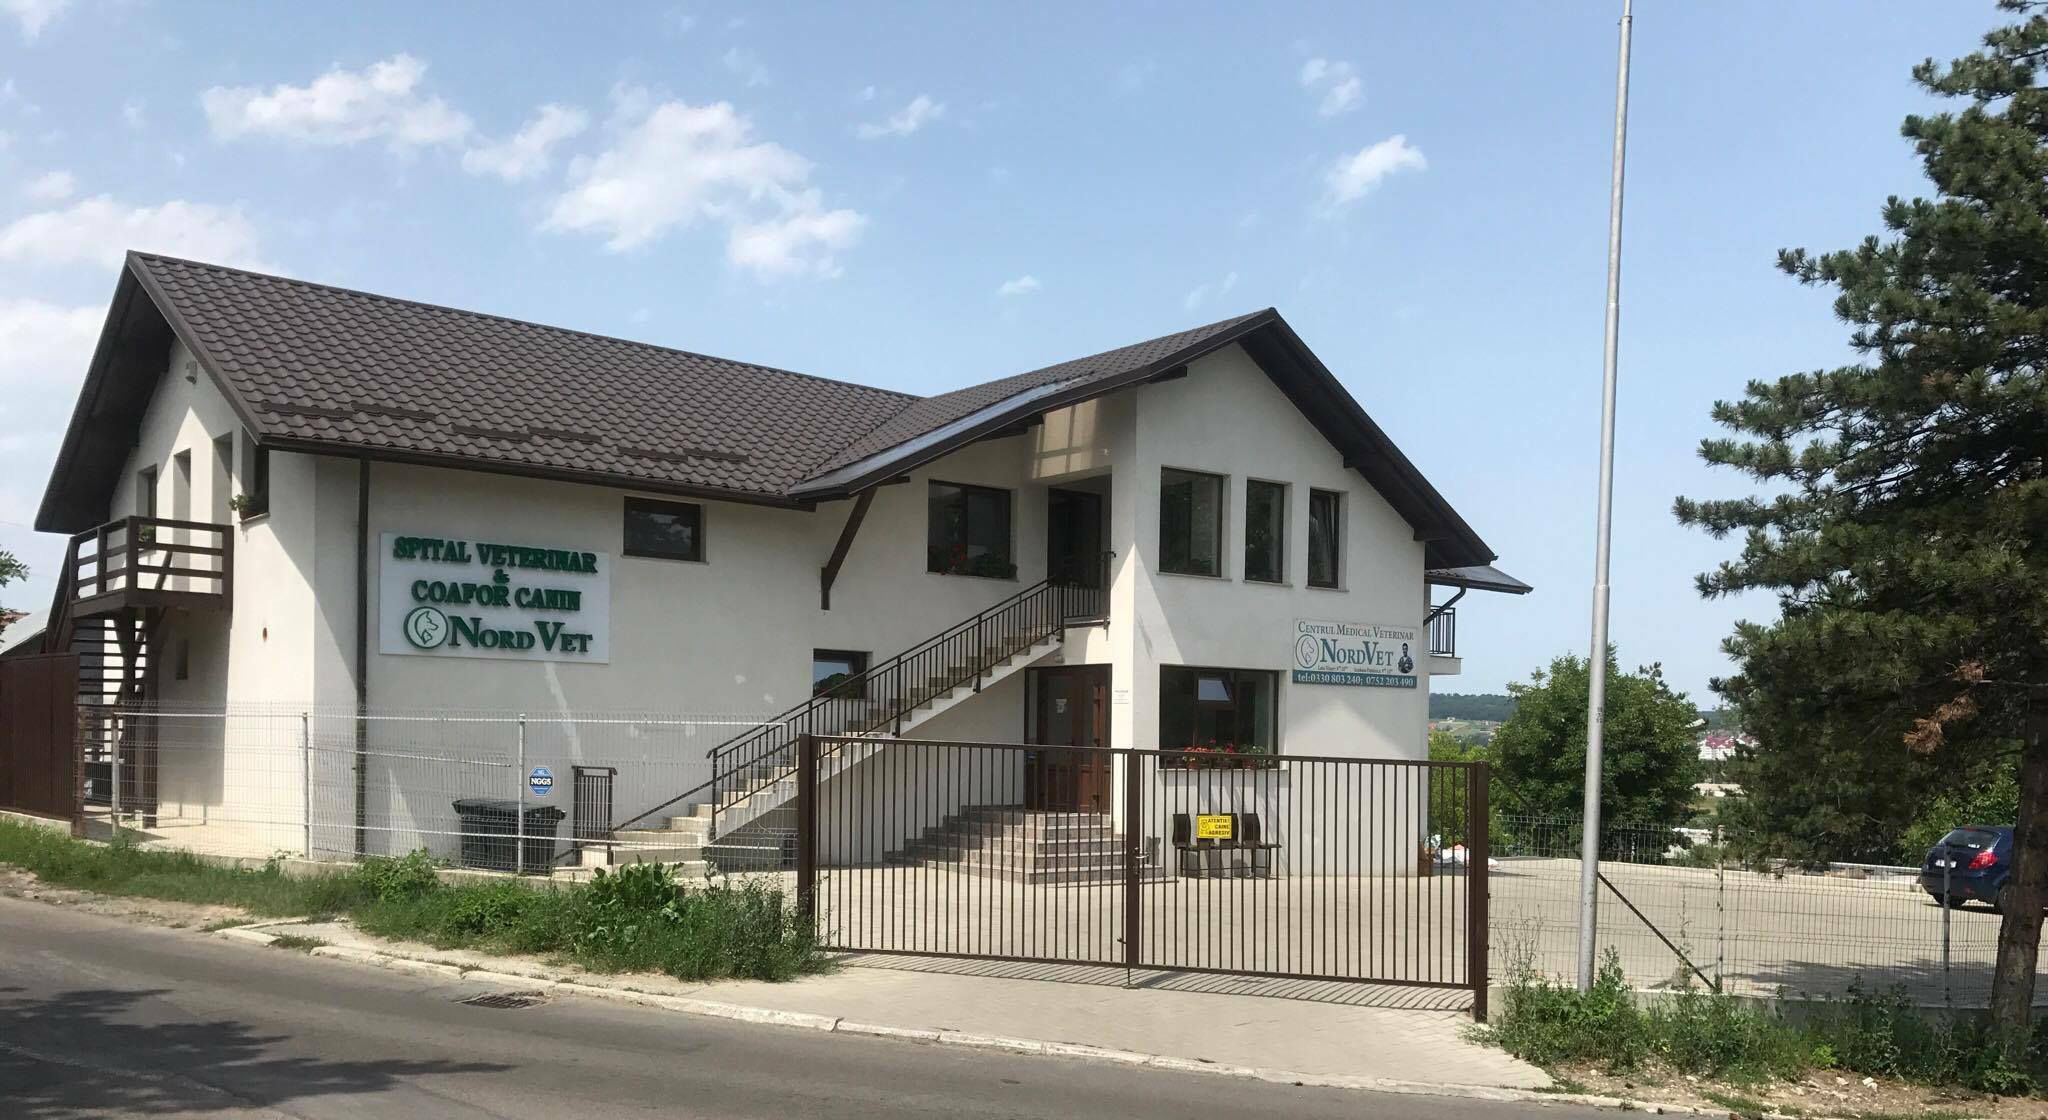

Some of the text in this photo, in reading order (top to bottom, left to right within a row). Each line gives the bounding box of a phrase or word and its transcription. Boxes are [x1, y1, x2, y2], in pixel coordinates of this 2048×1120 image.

[393, 536, 599, 573] SPITAL VETERINAR
[492, 568, 510, 584] &
[411, 580, 582, 611] COAFOR CANIN
[1298, 621, 1414, 640] CENTRUL MEDICAL VETERINAR
[1331, 674, 1345, 684] 803
[1366, 676, 1384, 686] 0752
[531, 777, 551, 785] NGGS
